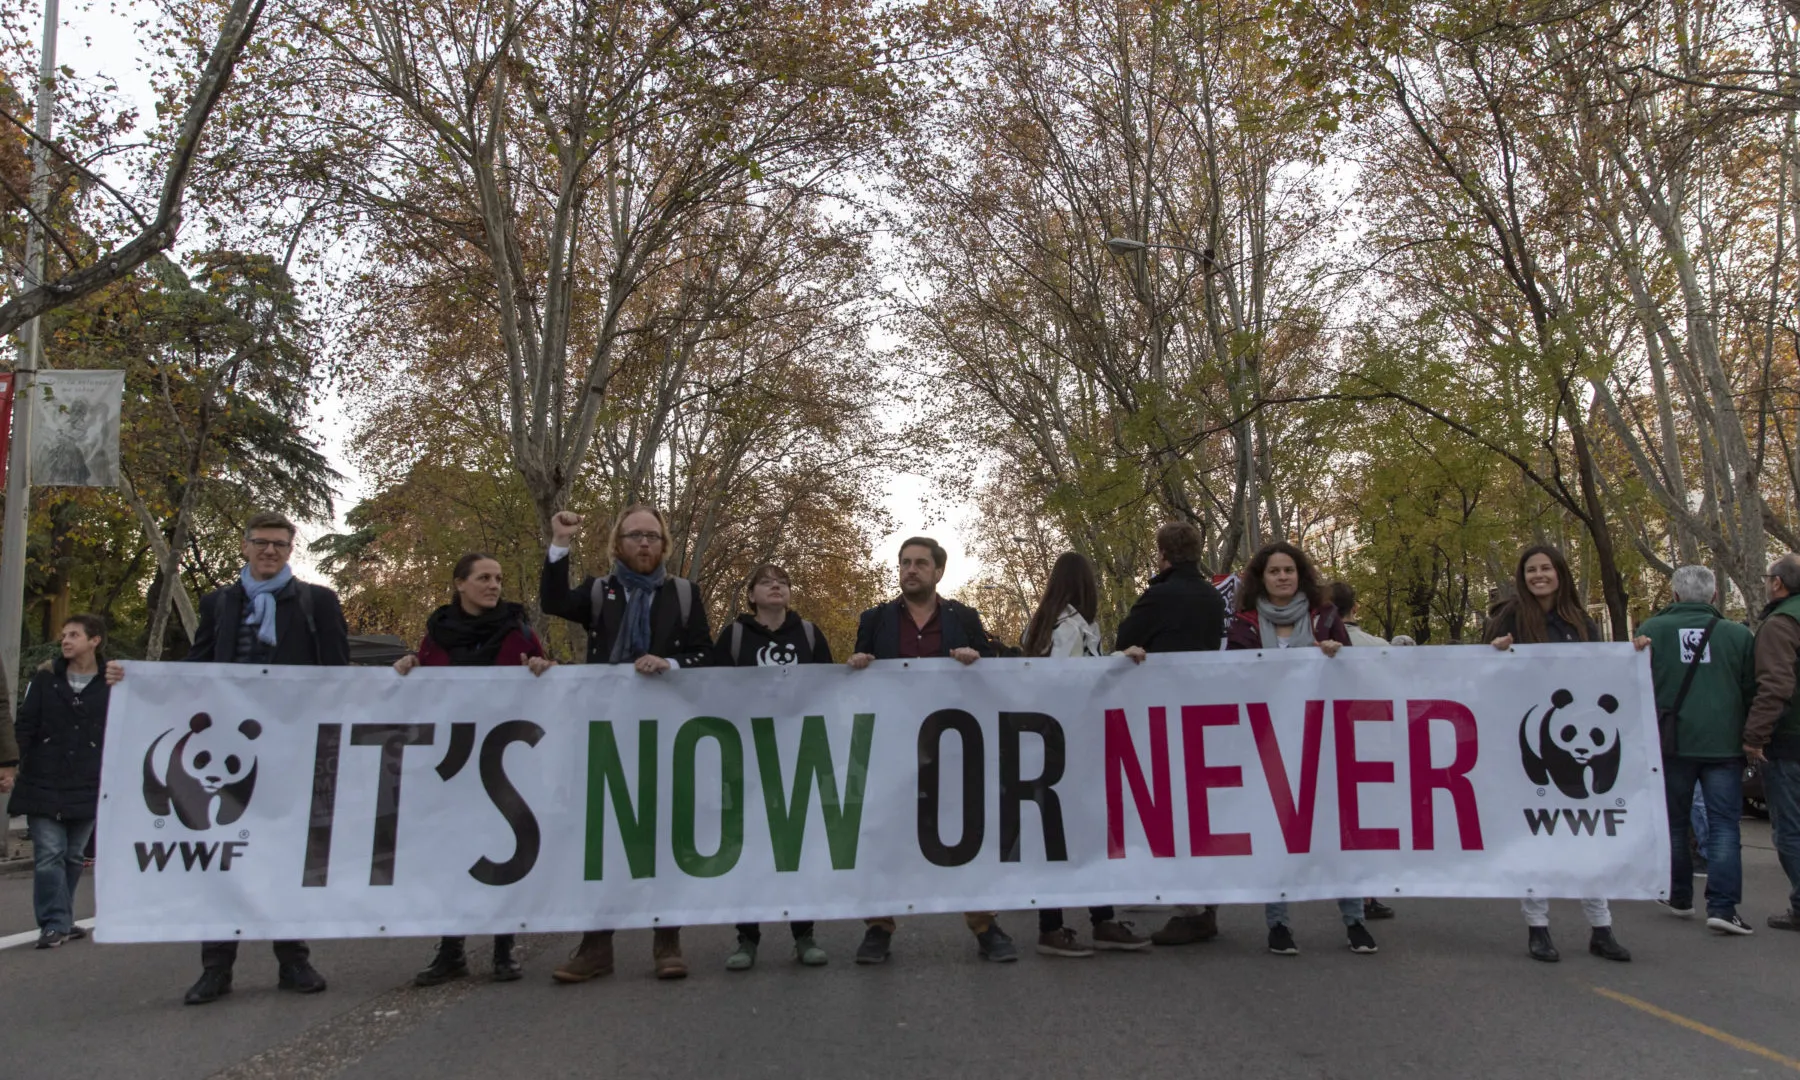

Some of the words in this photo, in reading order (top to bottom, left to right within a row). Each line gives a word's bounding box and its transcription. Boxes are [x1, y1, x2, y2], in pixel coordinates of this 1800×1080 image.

[303, 720, 545, 887] IT'S
[583, 713, 876, 882] NOW
[917, 709, 1068, 868] OR
[1104, 700, 1485, 860] NEVER
[1523, 808, 1627, 837] WWF
[134, 841, 249, 873] WWF
